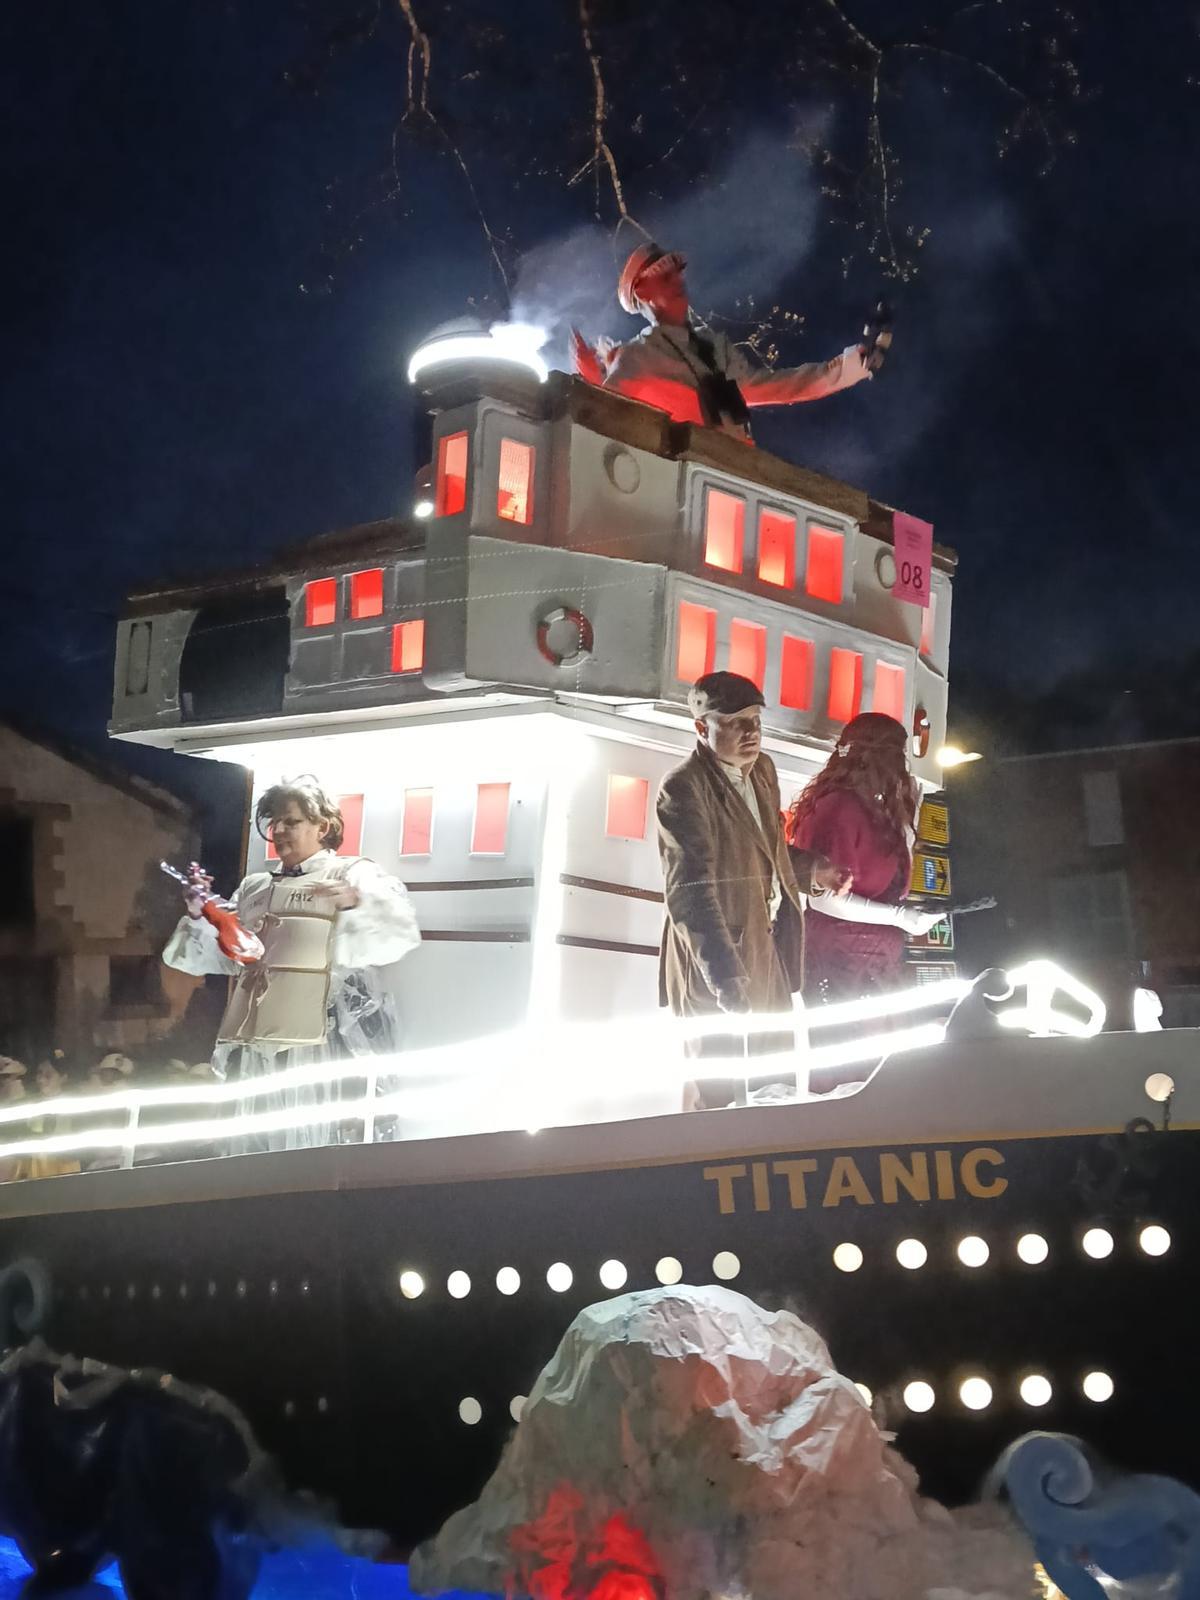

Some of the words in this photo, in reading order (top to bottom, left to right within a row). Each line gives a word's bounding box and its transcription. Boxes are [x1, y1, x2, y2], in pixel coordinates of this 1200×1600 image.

[901, 561, 923, 589] 08
[290, 892, 313, 902] 1912
[703, 1148, 1008, 1214] TITANIC
